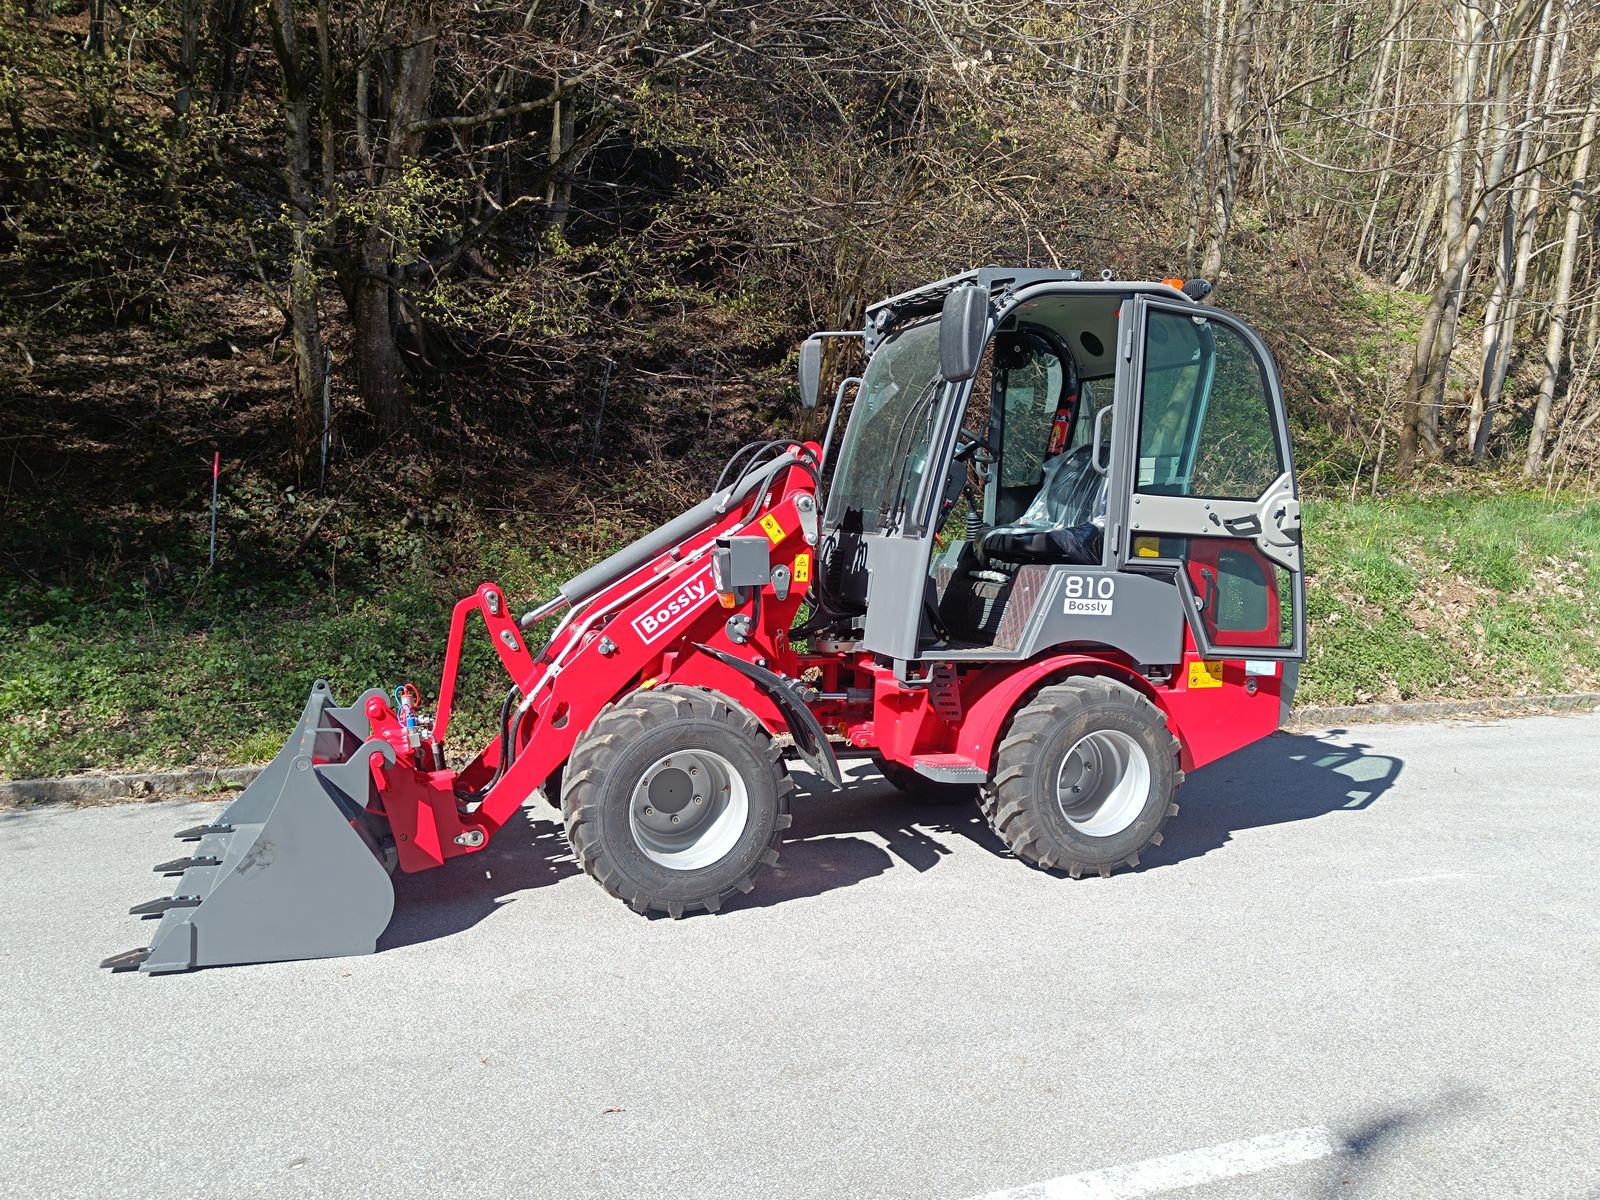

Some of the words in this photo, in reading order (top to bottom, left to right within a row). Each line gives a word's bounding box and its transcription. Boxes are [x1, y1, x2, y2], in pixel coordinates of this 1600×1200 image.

[1065, 576, 1115, 599] 810
[640, 580, 706, 634] Bossly
[1068, 601, 1108, 613] Bossly
